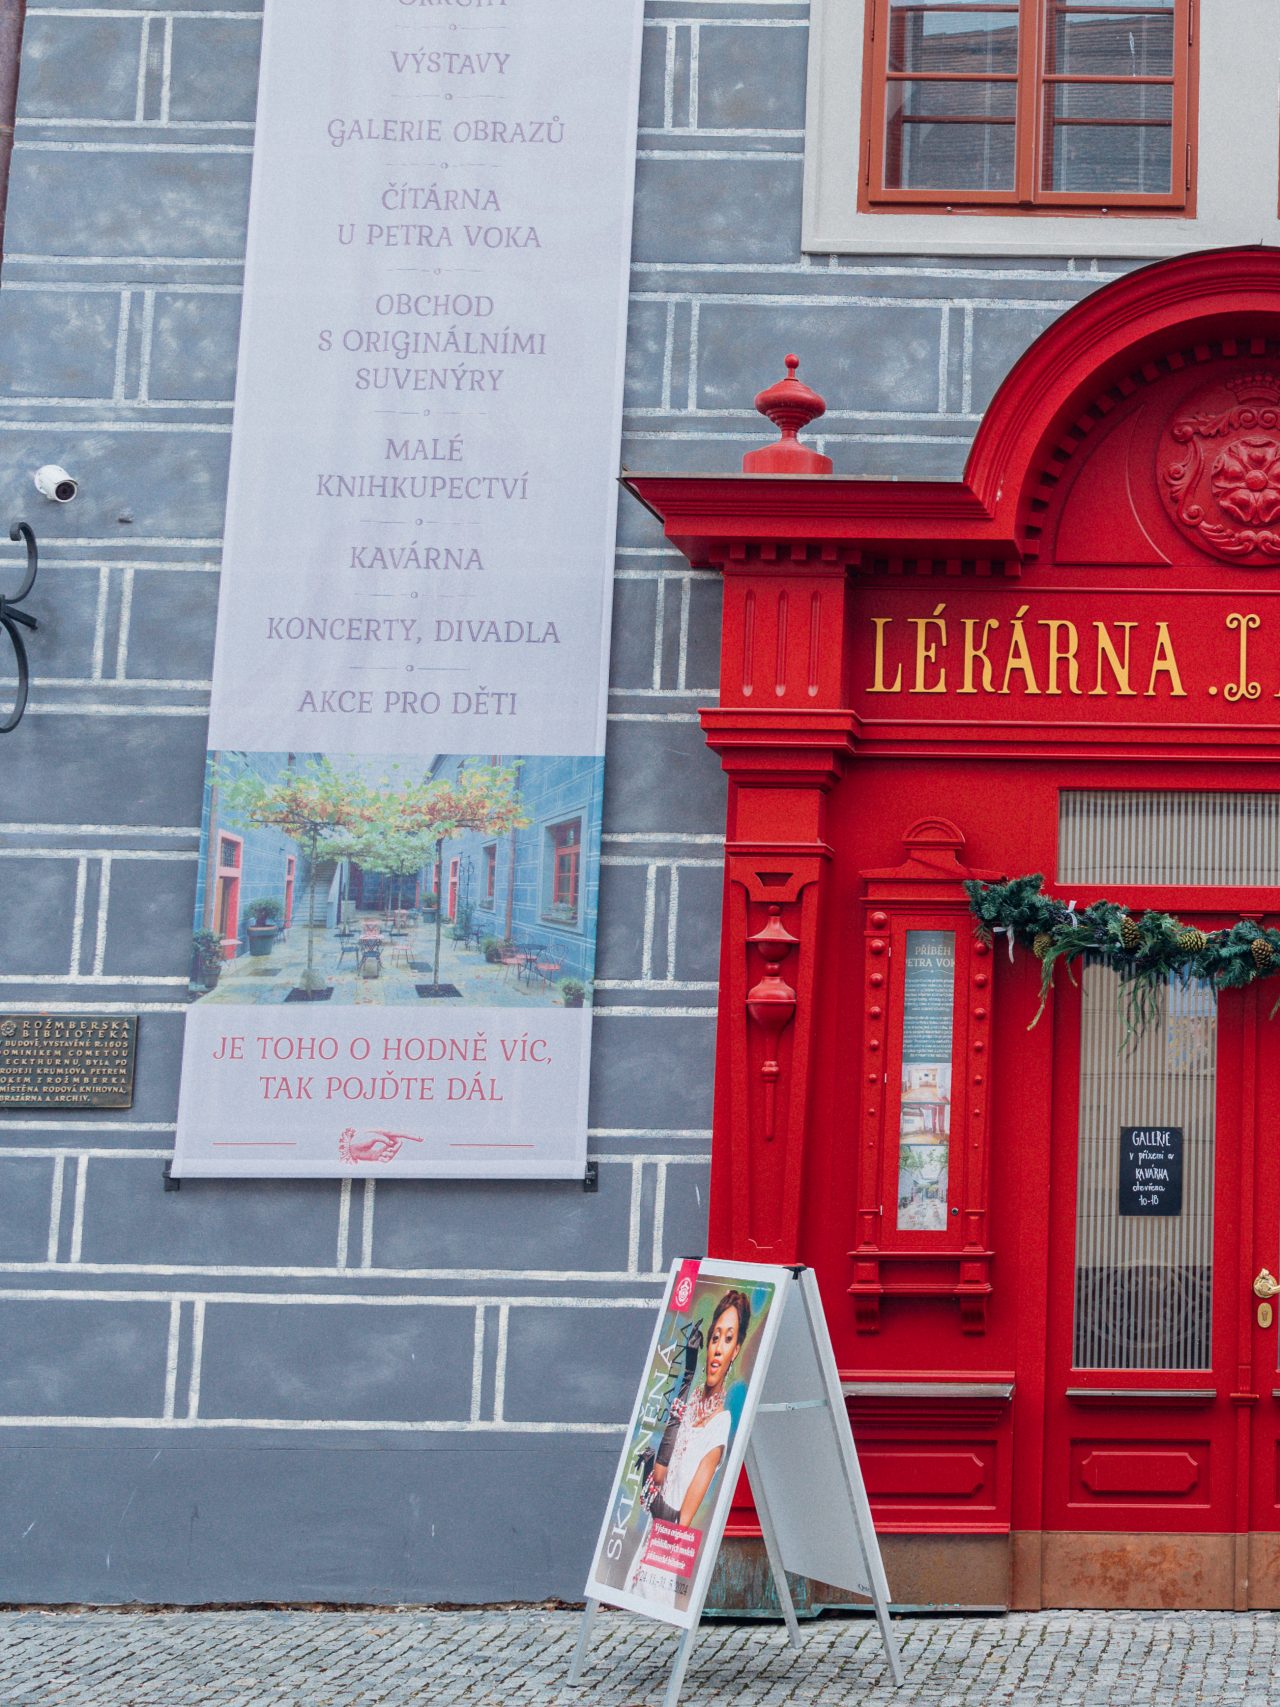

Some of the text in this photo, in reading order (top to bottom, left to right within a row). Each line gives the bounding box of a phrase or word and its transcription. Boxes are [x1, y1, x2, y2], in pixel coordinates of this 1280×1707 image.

[390, 46, 511, 75] VÝSTAVY
[327, 115, 565, 148] GALERIE OBRAZŮ
[381, 182, 502, 212] ČÍTÁRNA
[338, 224, 542, 249] U PETRA VOKA
[375, 294, 494, 319] OBCHOD
[318, 325, 547, 360] S ORIGINÁLNÍMI
[355, 363, 504, 392] SUVENÝRY
[384, 432, 464, 462] MALÉ
[316, 471, 529, 501] KNIHKUPECTVÍ
[349, 540, 485, 572] KAVÁRNA
[267, 617, 561, 646] KONCERTY, DIVADLA
[869, 603, 1188, 696] LÉKÁRNA
[297, 685, 518, 716] AKCE PRO DĚTI
[905, 958, 933, 967] ETRA
[915, 944, 951, 955] PŘÍBĚH
[23, 1019, 129, 1029] ROŽMBERSKÁ
[23, 1030, 128, 1038] BIBLIOTEKA
[213, 1031, 553, 1065] JE TOHO O HODNĚ VÍC,
[259, 1071, 504, 1101] TAK POJĎTE DÁL
